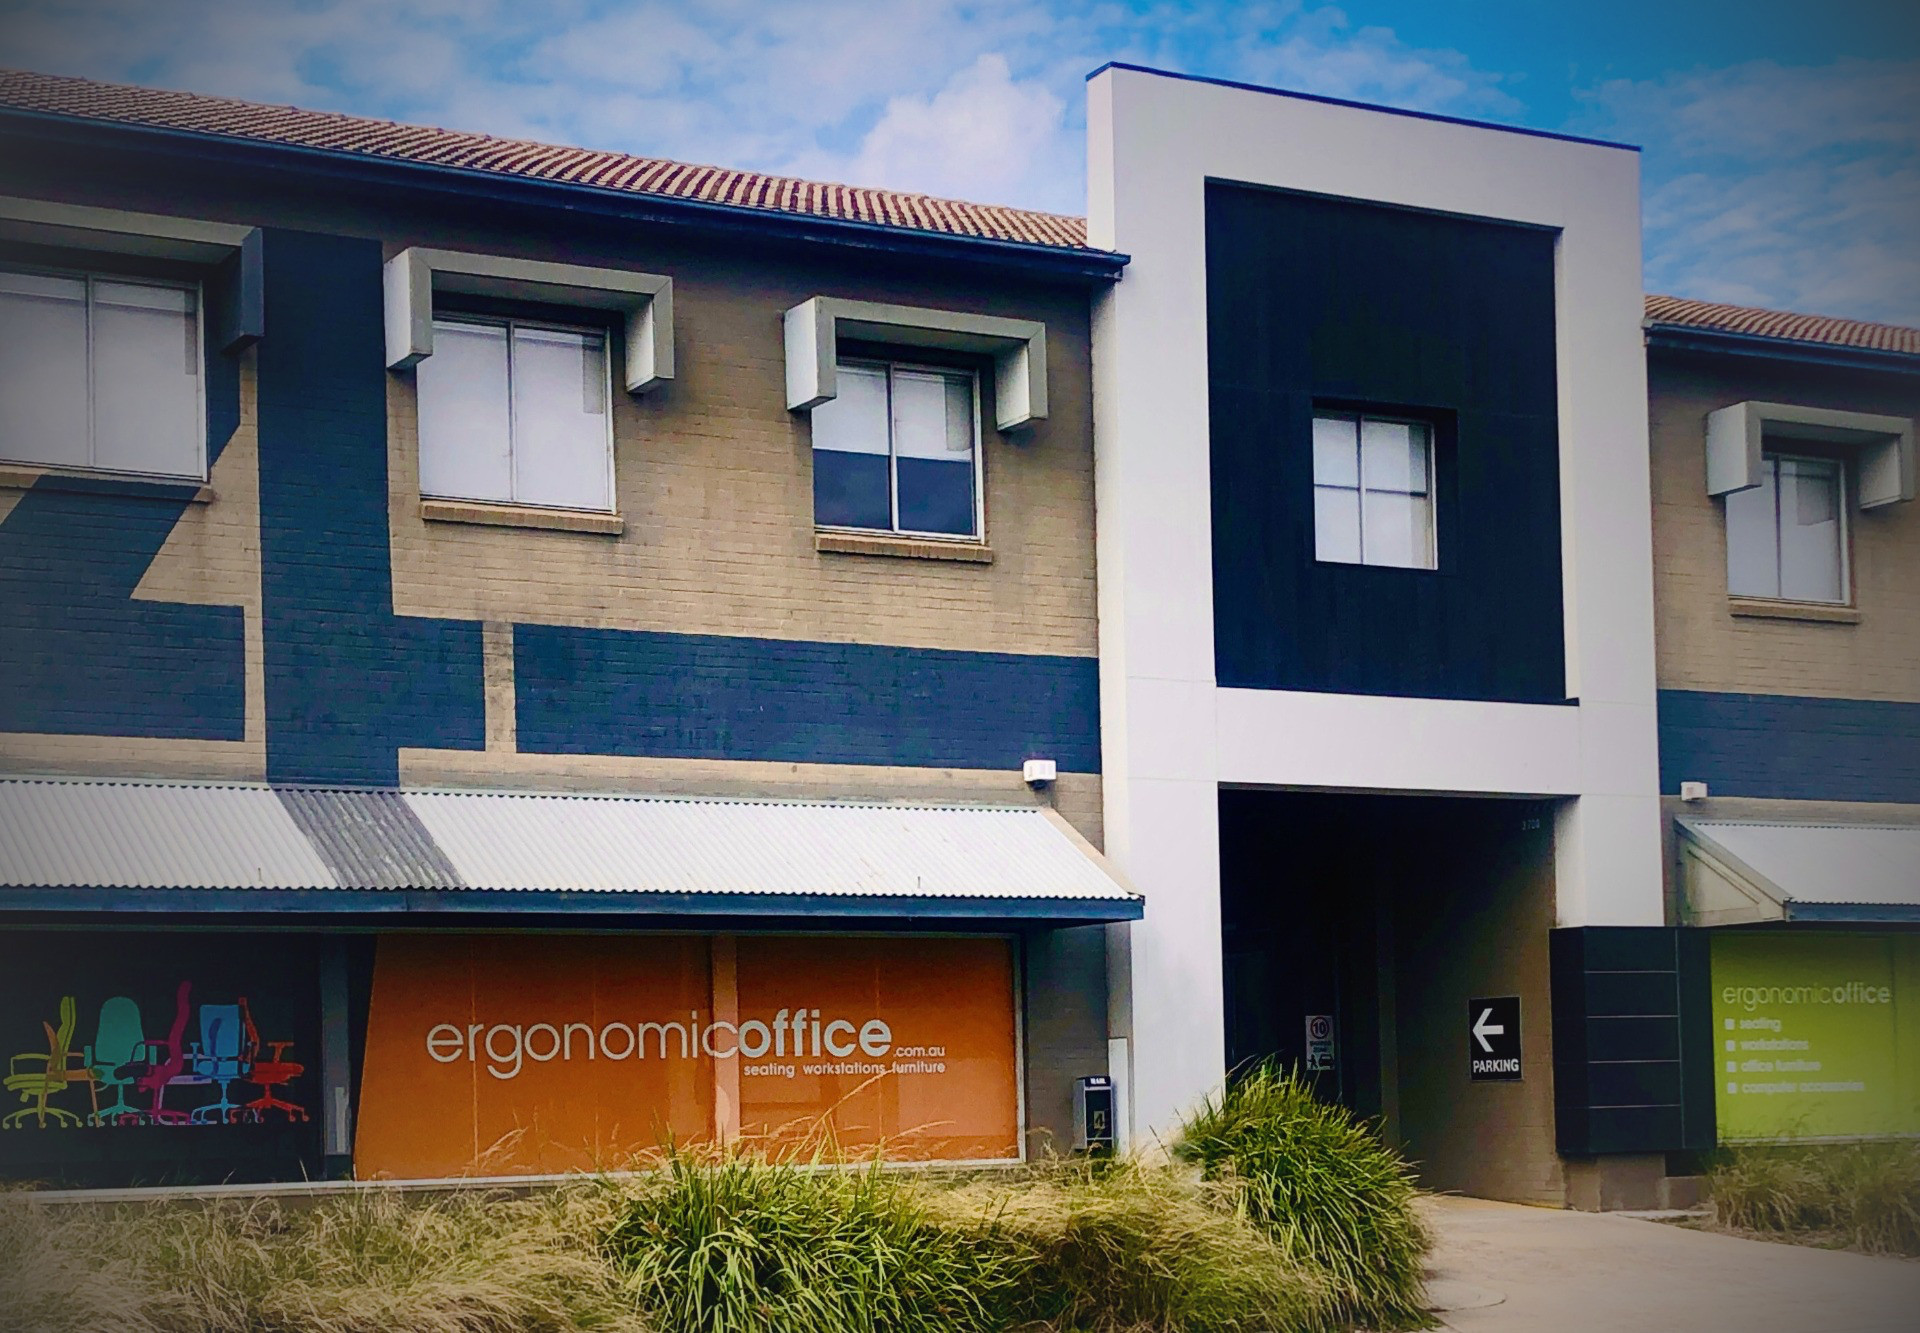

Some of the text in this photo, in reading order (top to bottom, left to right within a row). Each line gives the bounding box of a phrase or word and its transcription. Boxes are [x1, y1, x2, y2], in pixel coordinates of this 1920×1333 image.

[1313, 1021, 1326, 1034] 10
[743, 1060, 945, 1078] seating workstations furniture
[1472, 1058, 1519, 1073] PARKING
